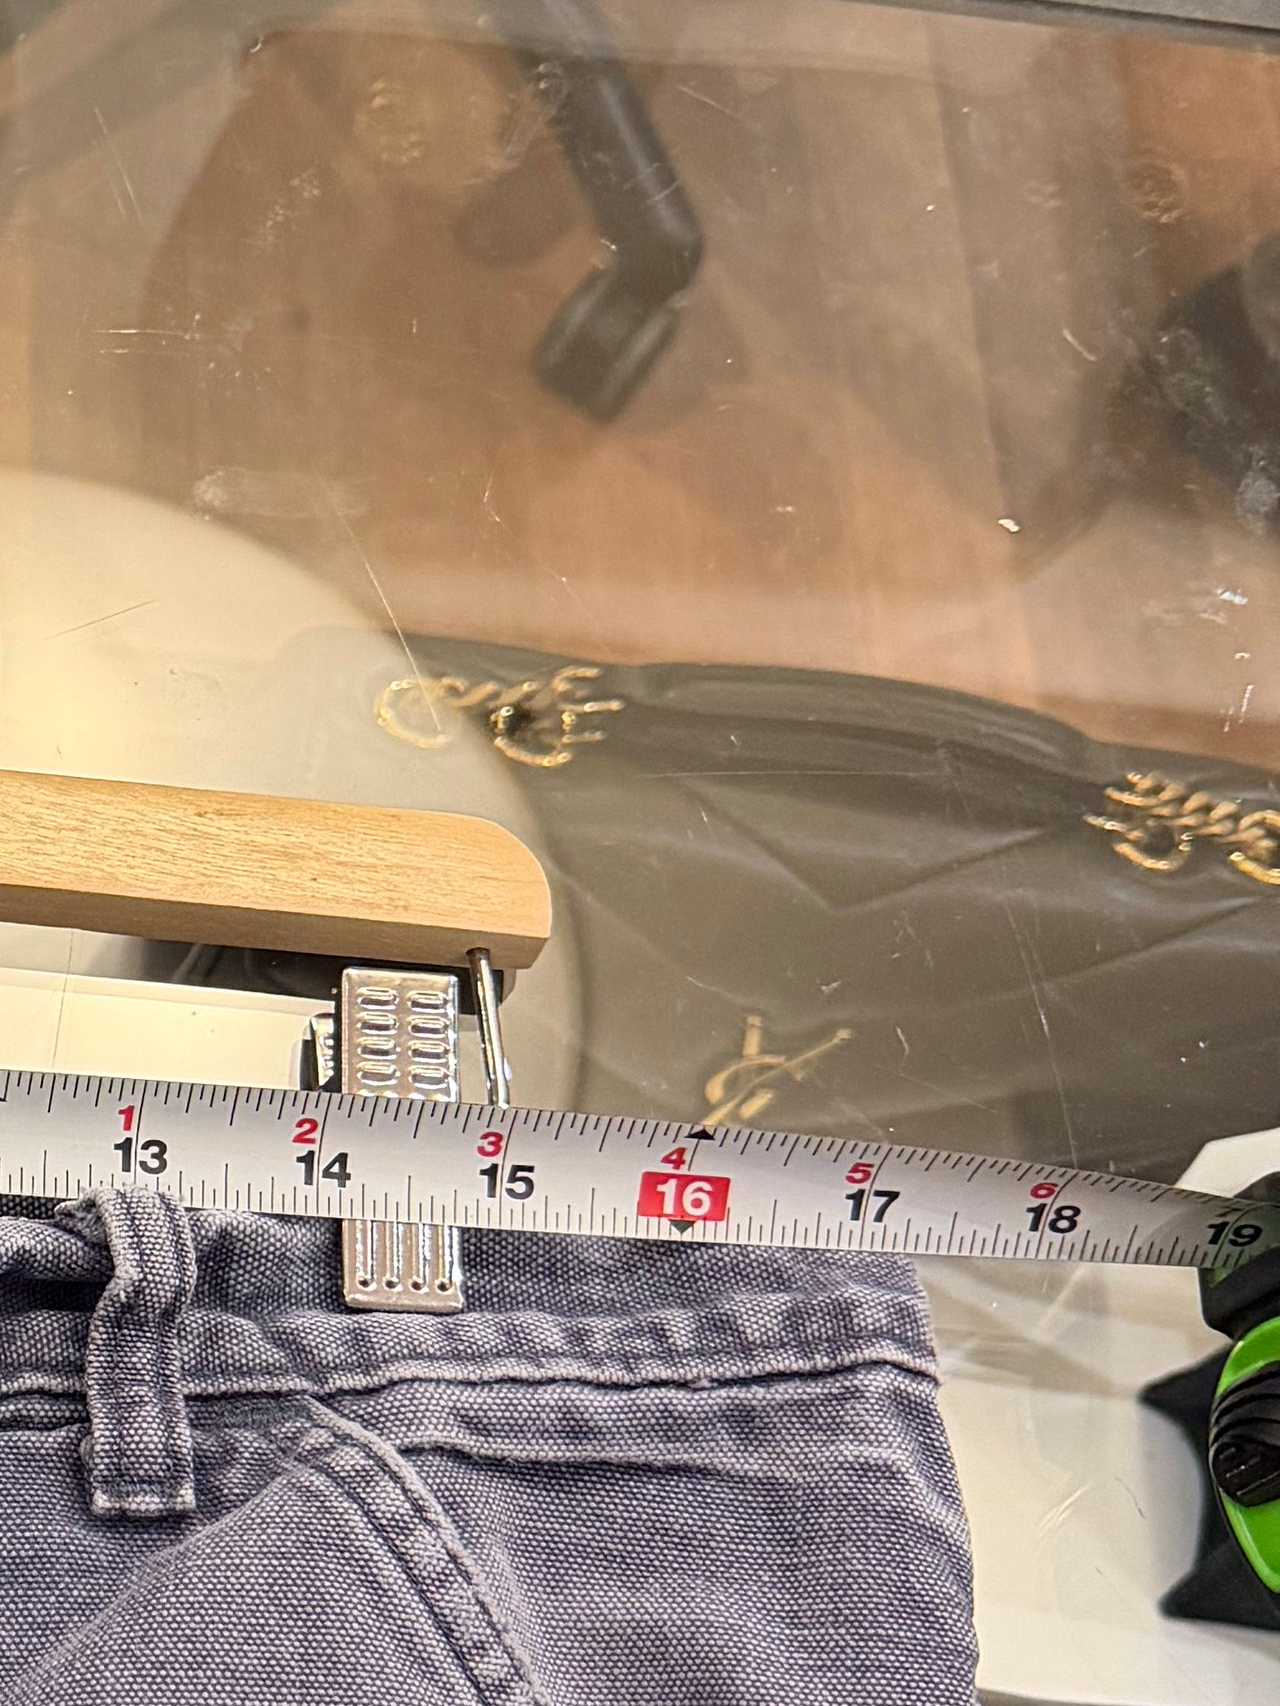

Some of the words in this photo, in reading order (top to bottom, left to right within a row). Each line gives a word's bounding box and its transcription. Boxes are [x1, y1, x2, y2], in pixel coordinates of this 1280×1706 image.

[117, 1104, 134, 1133] 1
[291, 1117, 319, 1145] 2
[113, 1138, 169, 1176] 13
[476, 1130, 504, 1158] 3
[659, 1146, 687, 1171] 4
[295, 1149, 352, 1189] 14
[478, 1162, 536, 1201] 15
[845, 1162, 874, 1185] 5
[655, 1179, 713, 1217] 16
[1029, 1182, 1058, 1201] 6
[844, 1189, 900, 1224] 17
[1025, 1204, 1082, 1235] 18
[1207, 1221, 1264, 1248] 19
